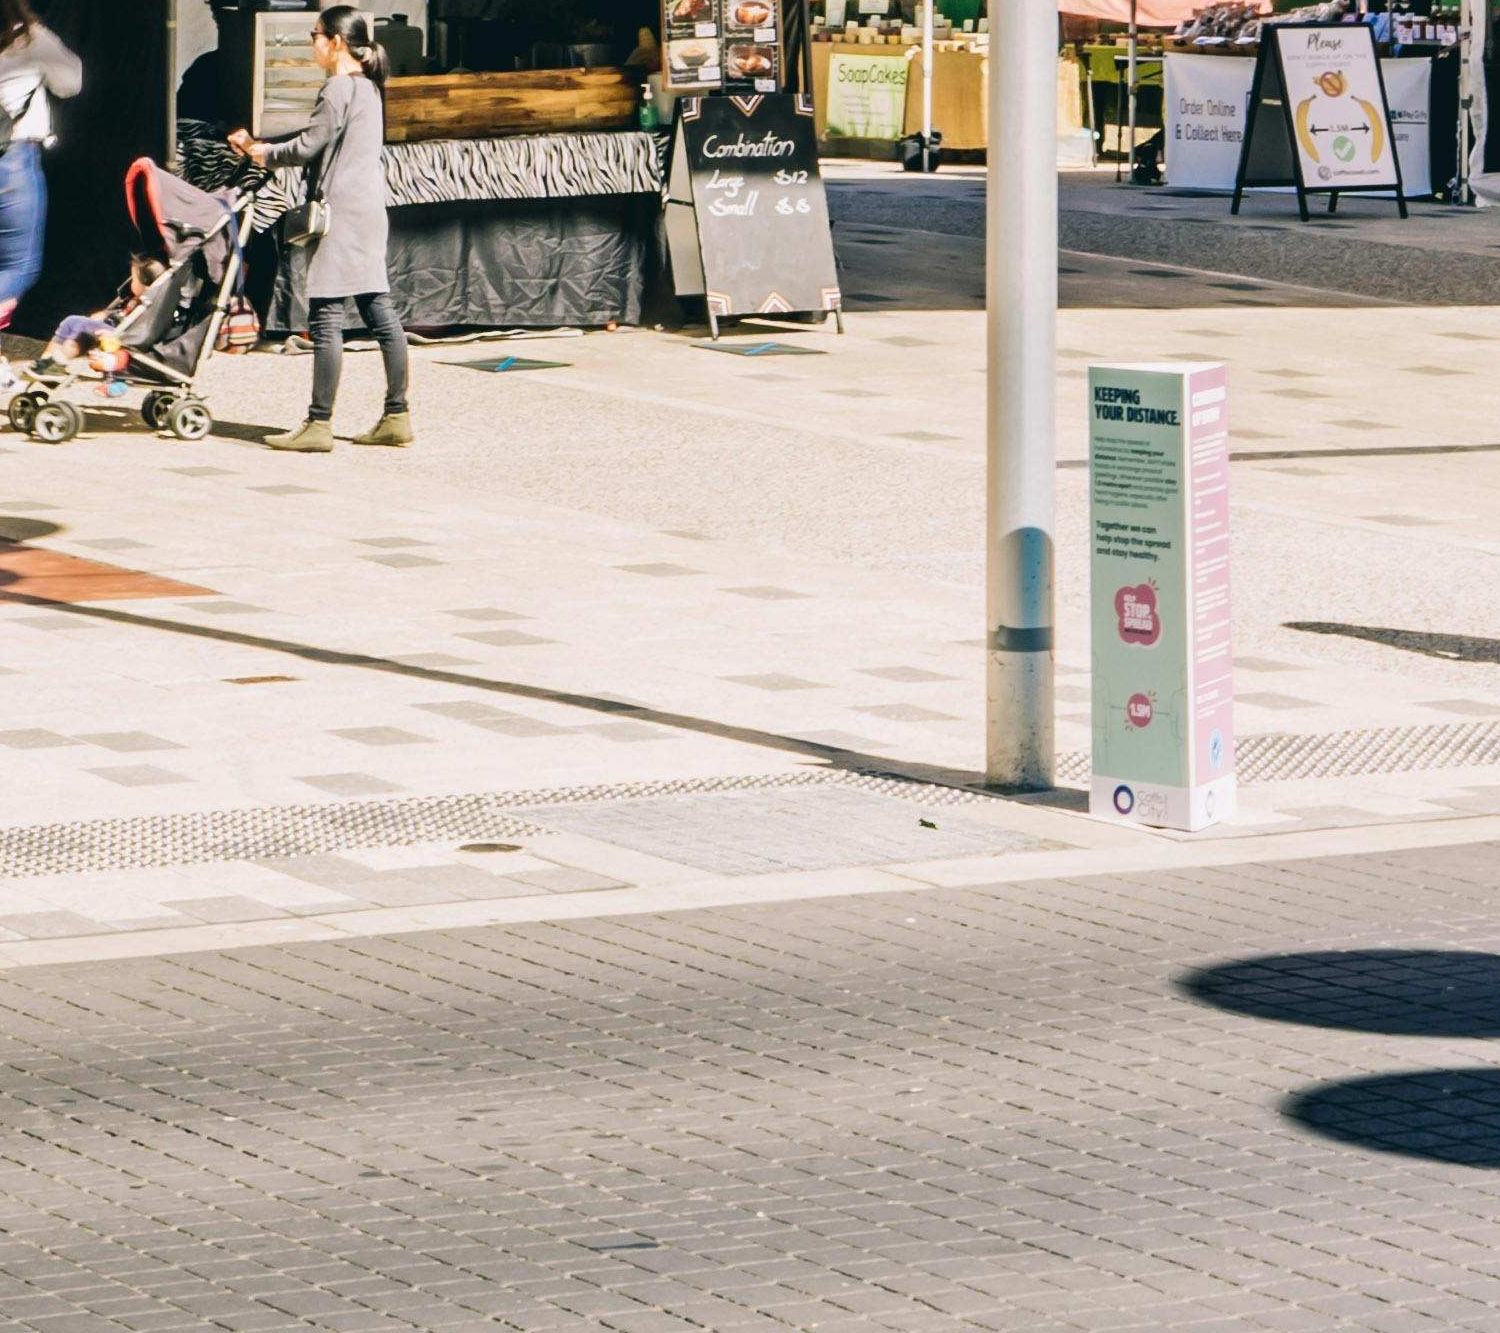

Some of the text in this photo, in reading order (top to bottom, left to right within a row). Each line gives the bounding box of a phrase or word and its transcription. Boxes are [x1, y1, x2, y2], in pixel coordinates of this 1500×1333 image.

[1307, 32, 1343, 52] Please
[1180, 98, 1237, 117] Order Online
[1185, 123, 1219, 141] Collect
[1221, 125, 1244, 143] Here
[703, 131, 795, 158] Combination
[705, 169, 808, 198] Large $12
[708, 190, 760, 217] Small
[1094, 386, 1140, 405] KEEPING
[1095, 404, 1124, 421] YOUR
[1126, 407, 1181, 426] DISTANCE.
